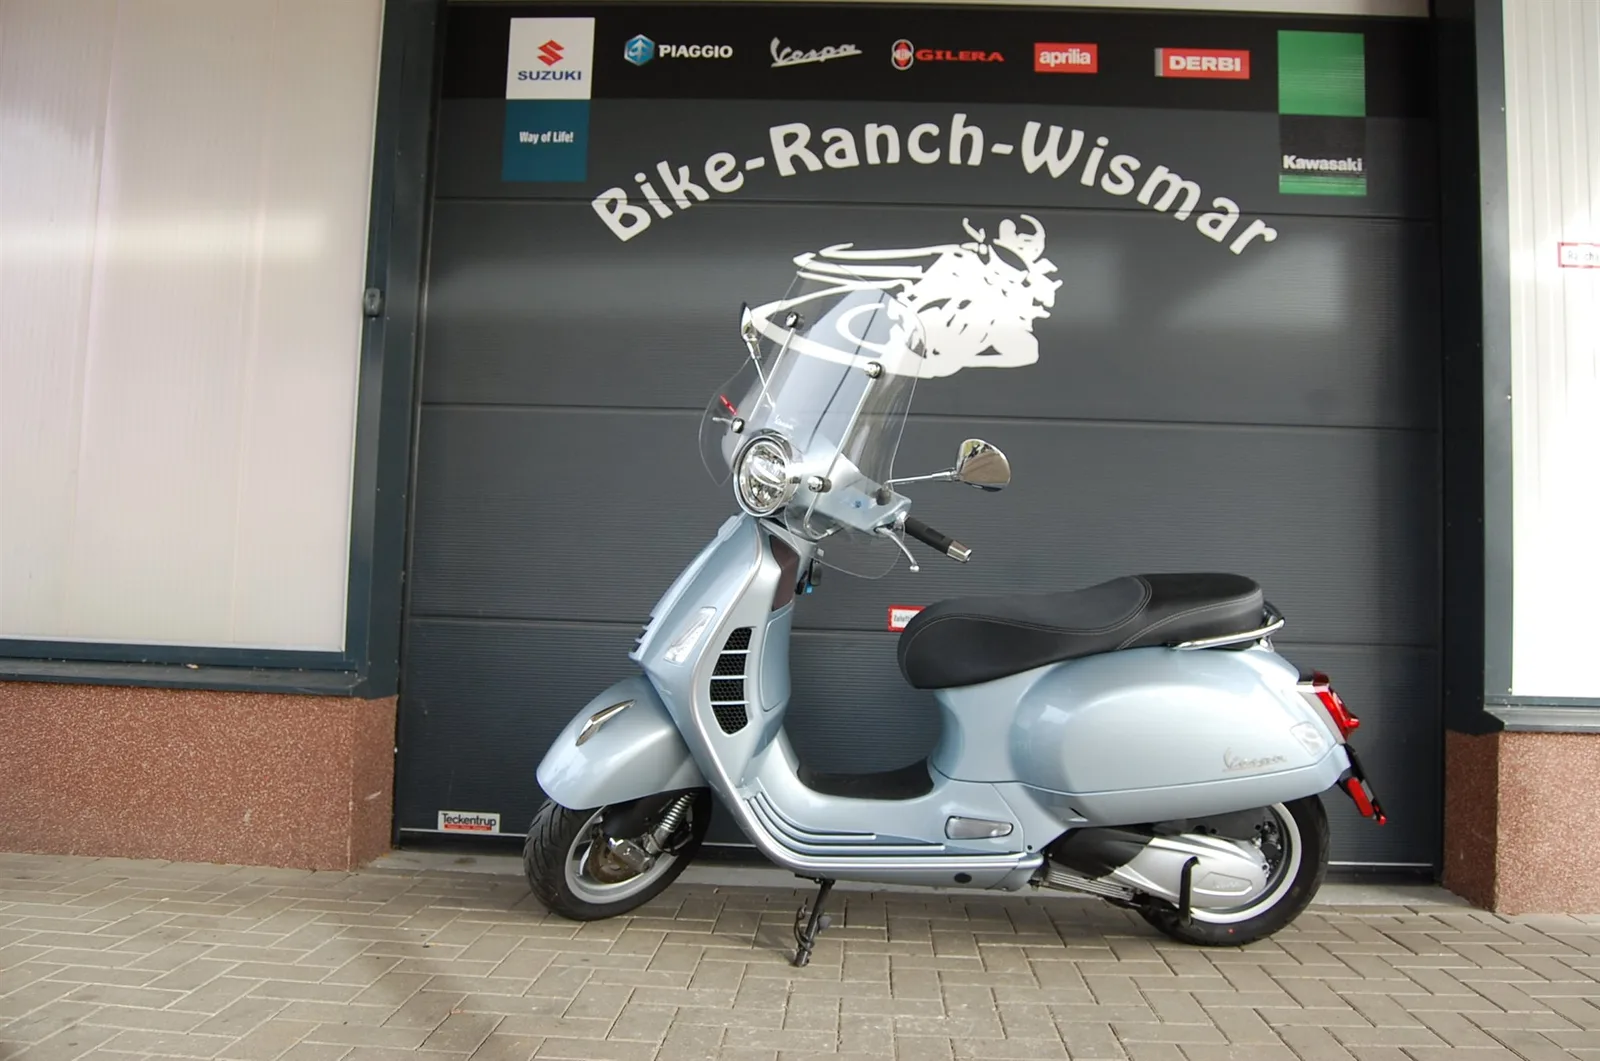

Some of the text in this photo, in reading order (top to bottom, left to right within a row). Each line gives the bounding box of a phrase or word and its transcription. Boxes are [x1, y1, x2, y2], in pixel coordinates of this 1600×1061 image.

[658, 44, 733, 60] PIAGGIO
[770, 37, 863, 68] Vespa
[915, 49, 1005, 62] GILERA
[1038, 48, 1092, 67] aprilia
[1168, 55, 1241, 73] DERBI
[518, 70, 582, 81] SUZUKI
[519, 131, 574, 145] Way of Life!
[1282, 154, 1364, 172] Kawasaki
[591, 113, 1278, 255] Bike-Ranch-Wismar
[442, 813, 497, 827] Teckentrup
